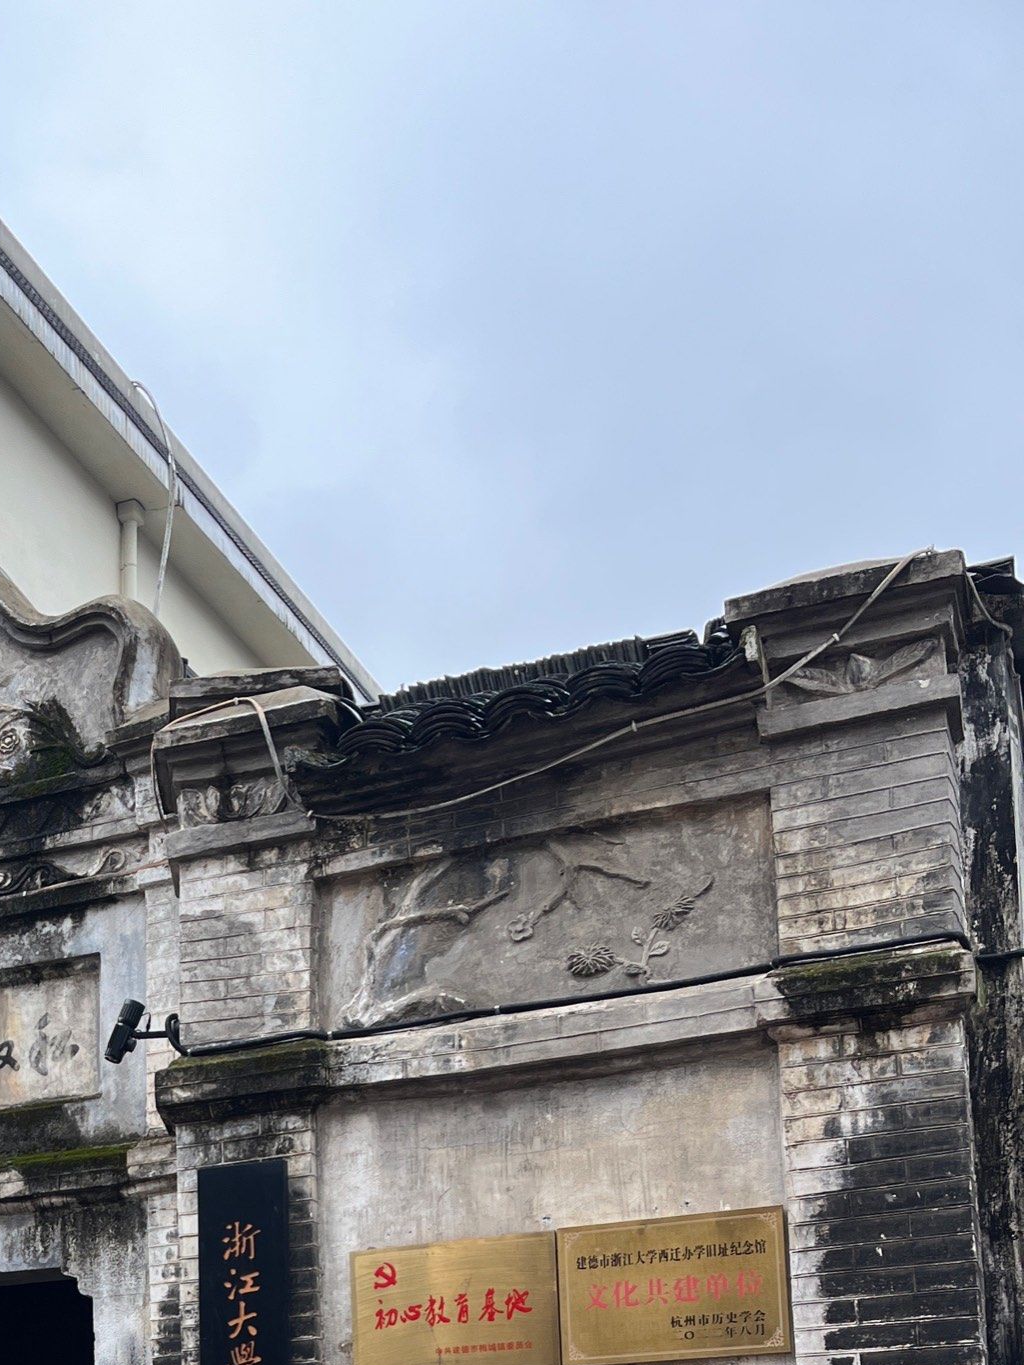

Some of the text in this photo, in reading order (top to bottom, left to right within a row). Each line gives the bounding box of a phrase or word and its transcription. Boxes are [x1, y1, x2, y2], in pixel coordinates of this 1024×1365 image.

[576, 1238, 767, 1270] 建德市浙江大学西迁办学旧址纪念馆
[585, 1268, 763, 1311] 文化共建单位
[374, 1287, 533, 1330] 初心教育基地
[670, 1309, 767, 1329] 杭州市历史学会
